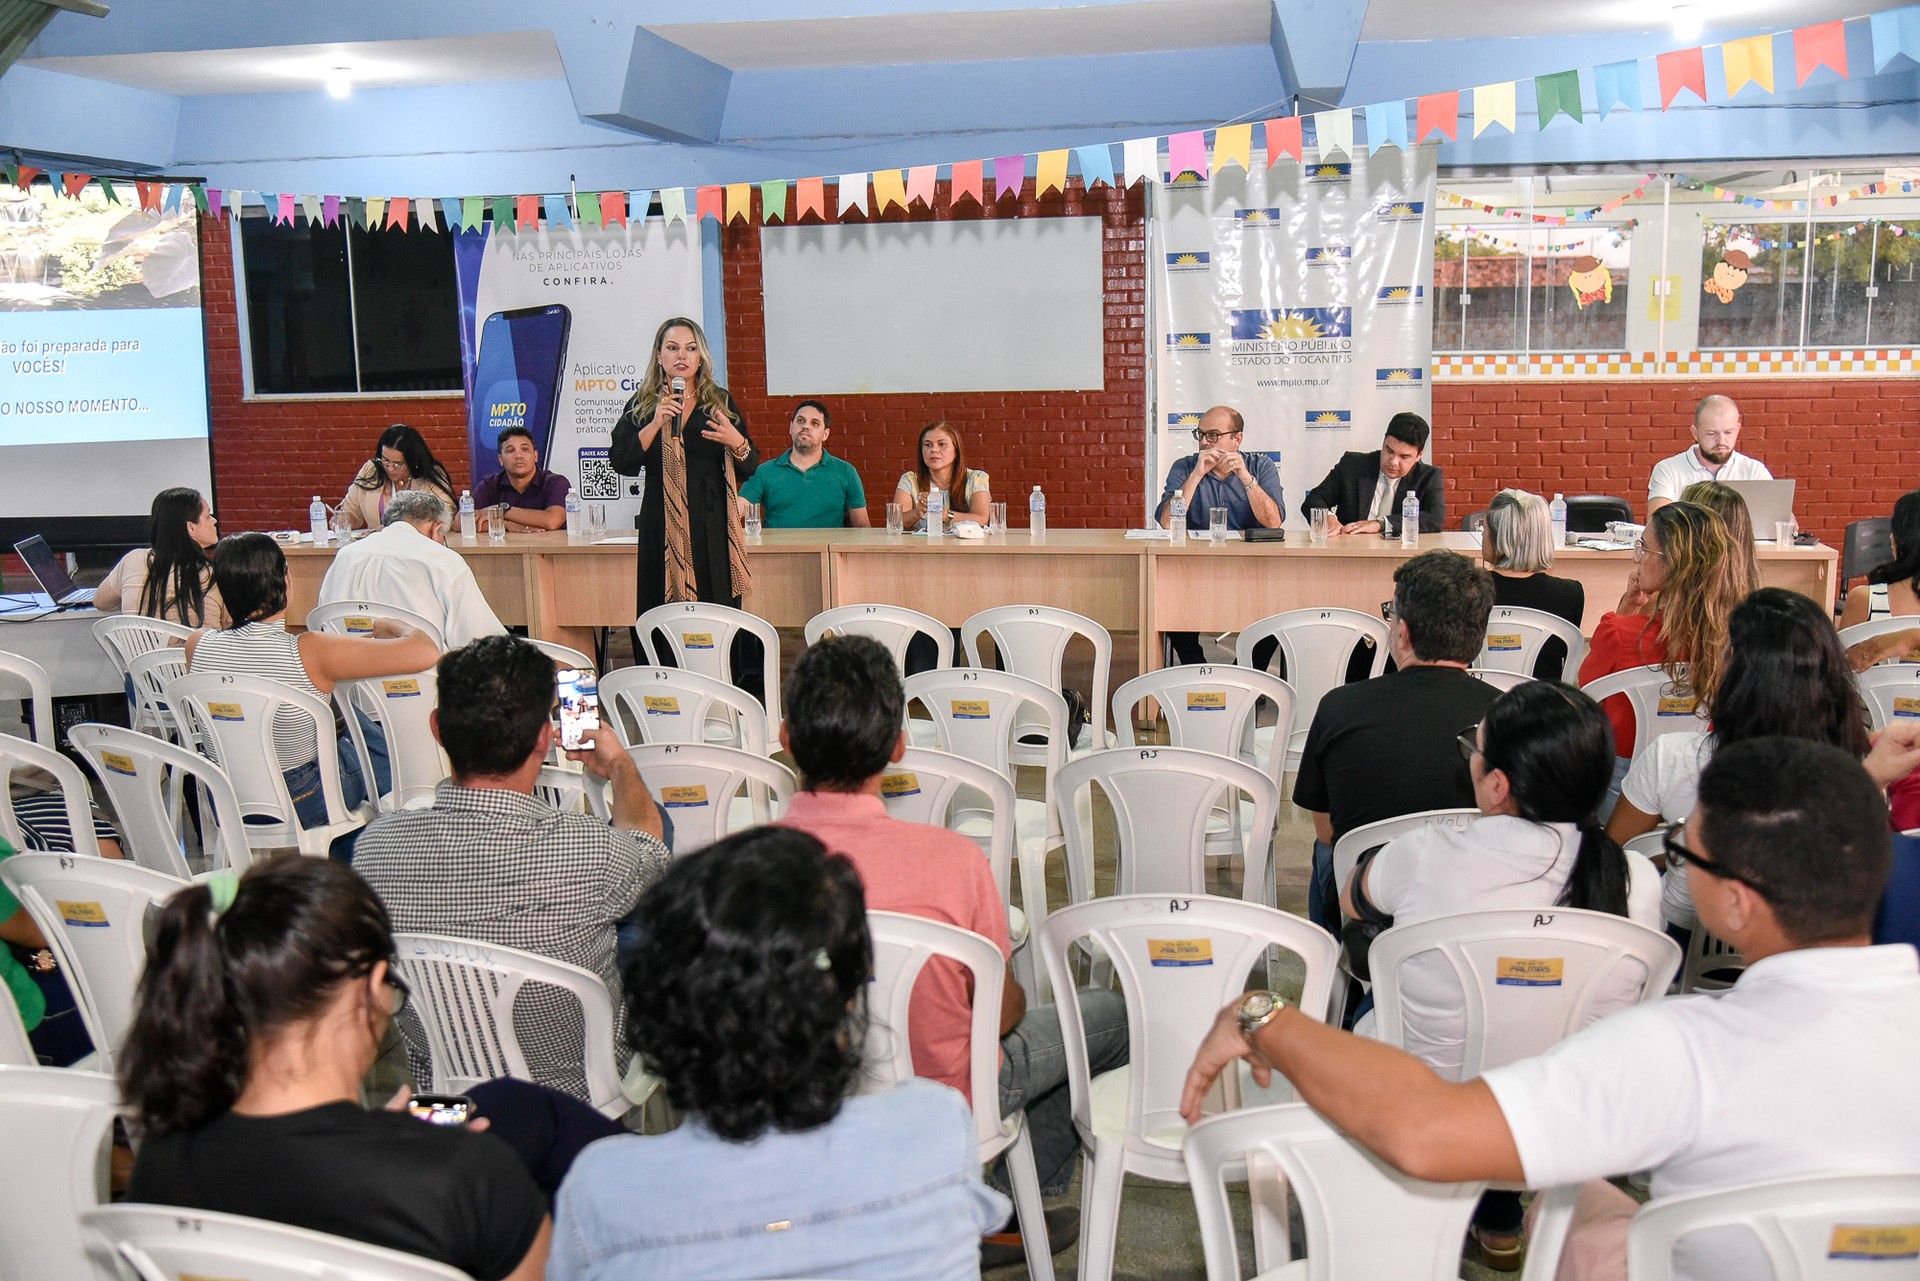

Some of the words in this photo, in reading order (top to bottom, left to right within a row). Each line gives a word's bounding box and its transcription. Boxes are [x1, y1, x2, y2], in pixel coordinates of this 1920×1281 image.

[512, 252, 535, 261] NAS
[539, 250, 602, 260] PRINCIPAIS
[606, 249, 642, 259] LOJAS
[529, 263, 543, 272] DE
[542, 276, 614, 286] CONFIRA.
[22, 340, 38, 353] foi
[42, 338, 107, 355] preparada
[111, 340, 140, 354] para
[13, 357, 65, 374] VOCÊS!
[1231, 356, 1271, 366] ESTADO
[1274, 355, 1291, 365] DO
[1293, 354, 1352, 365] TOCANTINS
[573, 362, 636, 378] Aplicativo
[575, 379, 617, 392] MPTO
[15, 400, 65, 415] NOSSO
[68, 398, 149, 413] MOMENTO...
[490, 402, 527, 417] MPTO
[489, 416, 525, 427] CIDADÃO
[589, 416, 615, 424] forma
[576, 425, 609, 434] prática,
[655, 672, 668, 680] AJ
[1200, 666, 1213, 676] AJ
[963, 673, 977, 681] AJ
[665, 745, 680, 753] AJ
[1140, 750, 1159, 760] AJ
[1170, 899, 1192, 913] AJ
[1533, 913, 1555, 928] AJ
[1508, 964, 1552, 973] PALMAS
